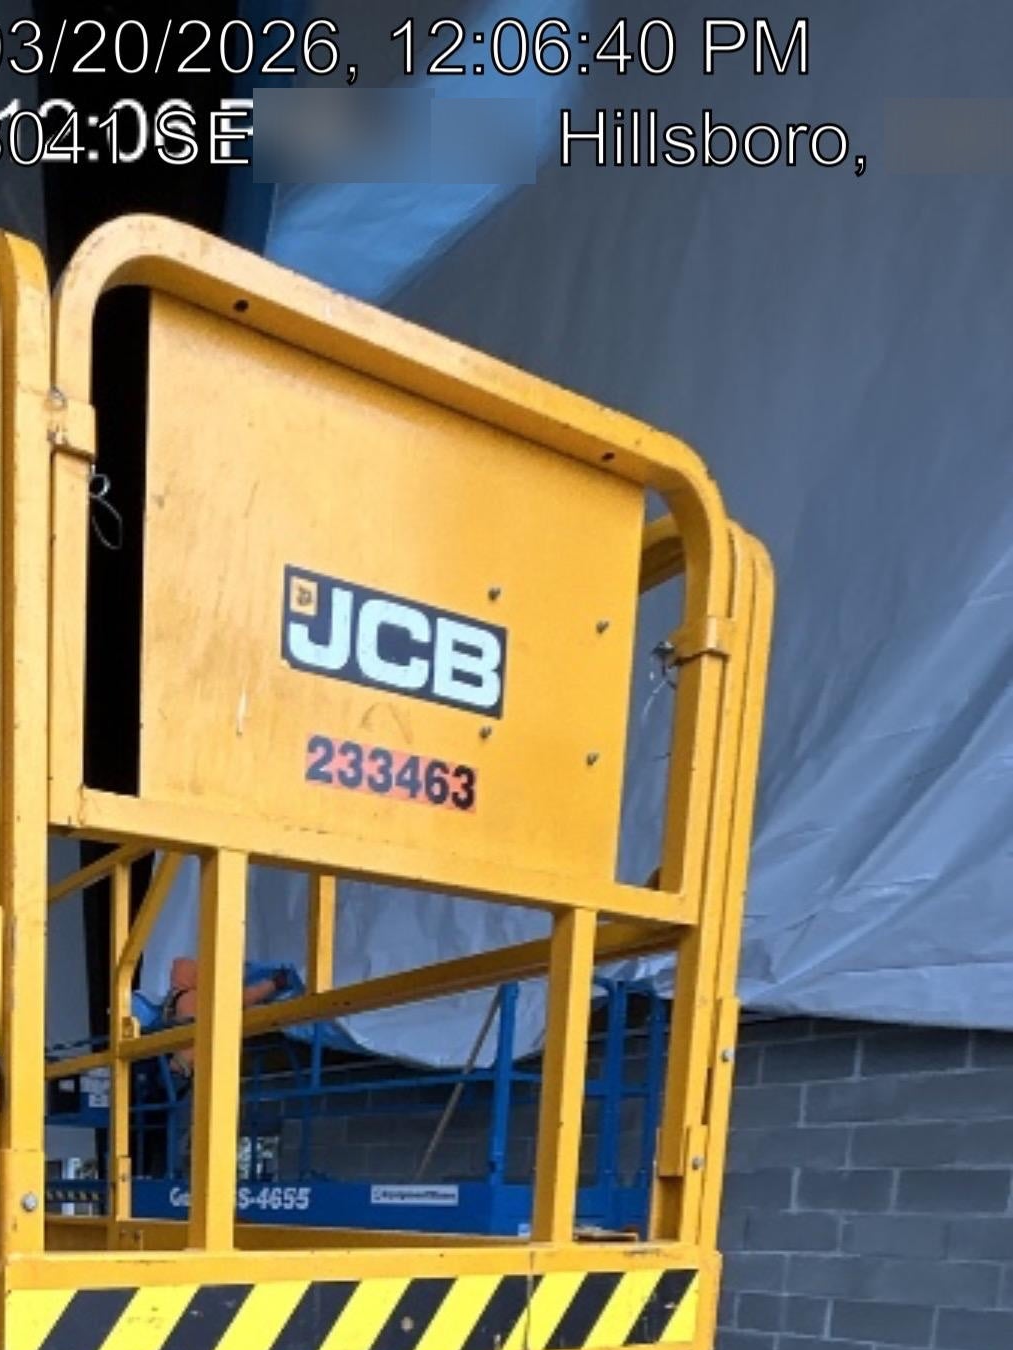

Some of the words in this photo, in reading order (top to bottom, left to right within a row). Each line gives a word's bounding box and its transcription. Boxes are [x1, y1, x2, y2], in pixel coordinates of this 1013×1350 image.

[290, 587, 501, 707] JCB
[306, 735, 475, 811] 233463
[236, 1187, 311, 1210] S-4655
